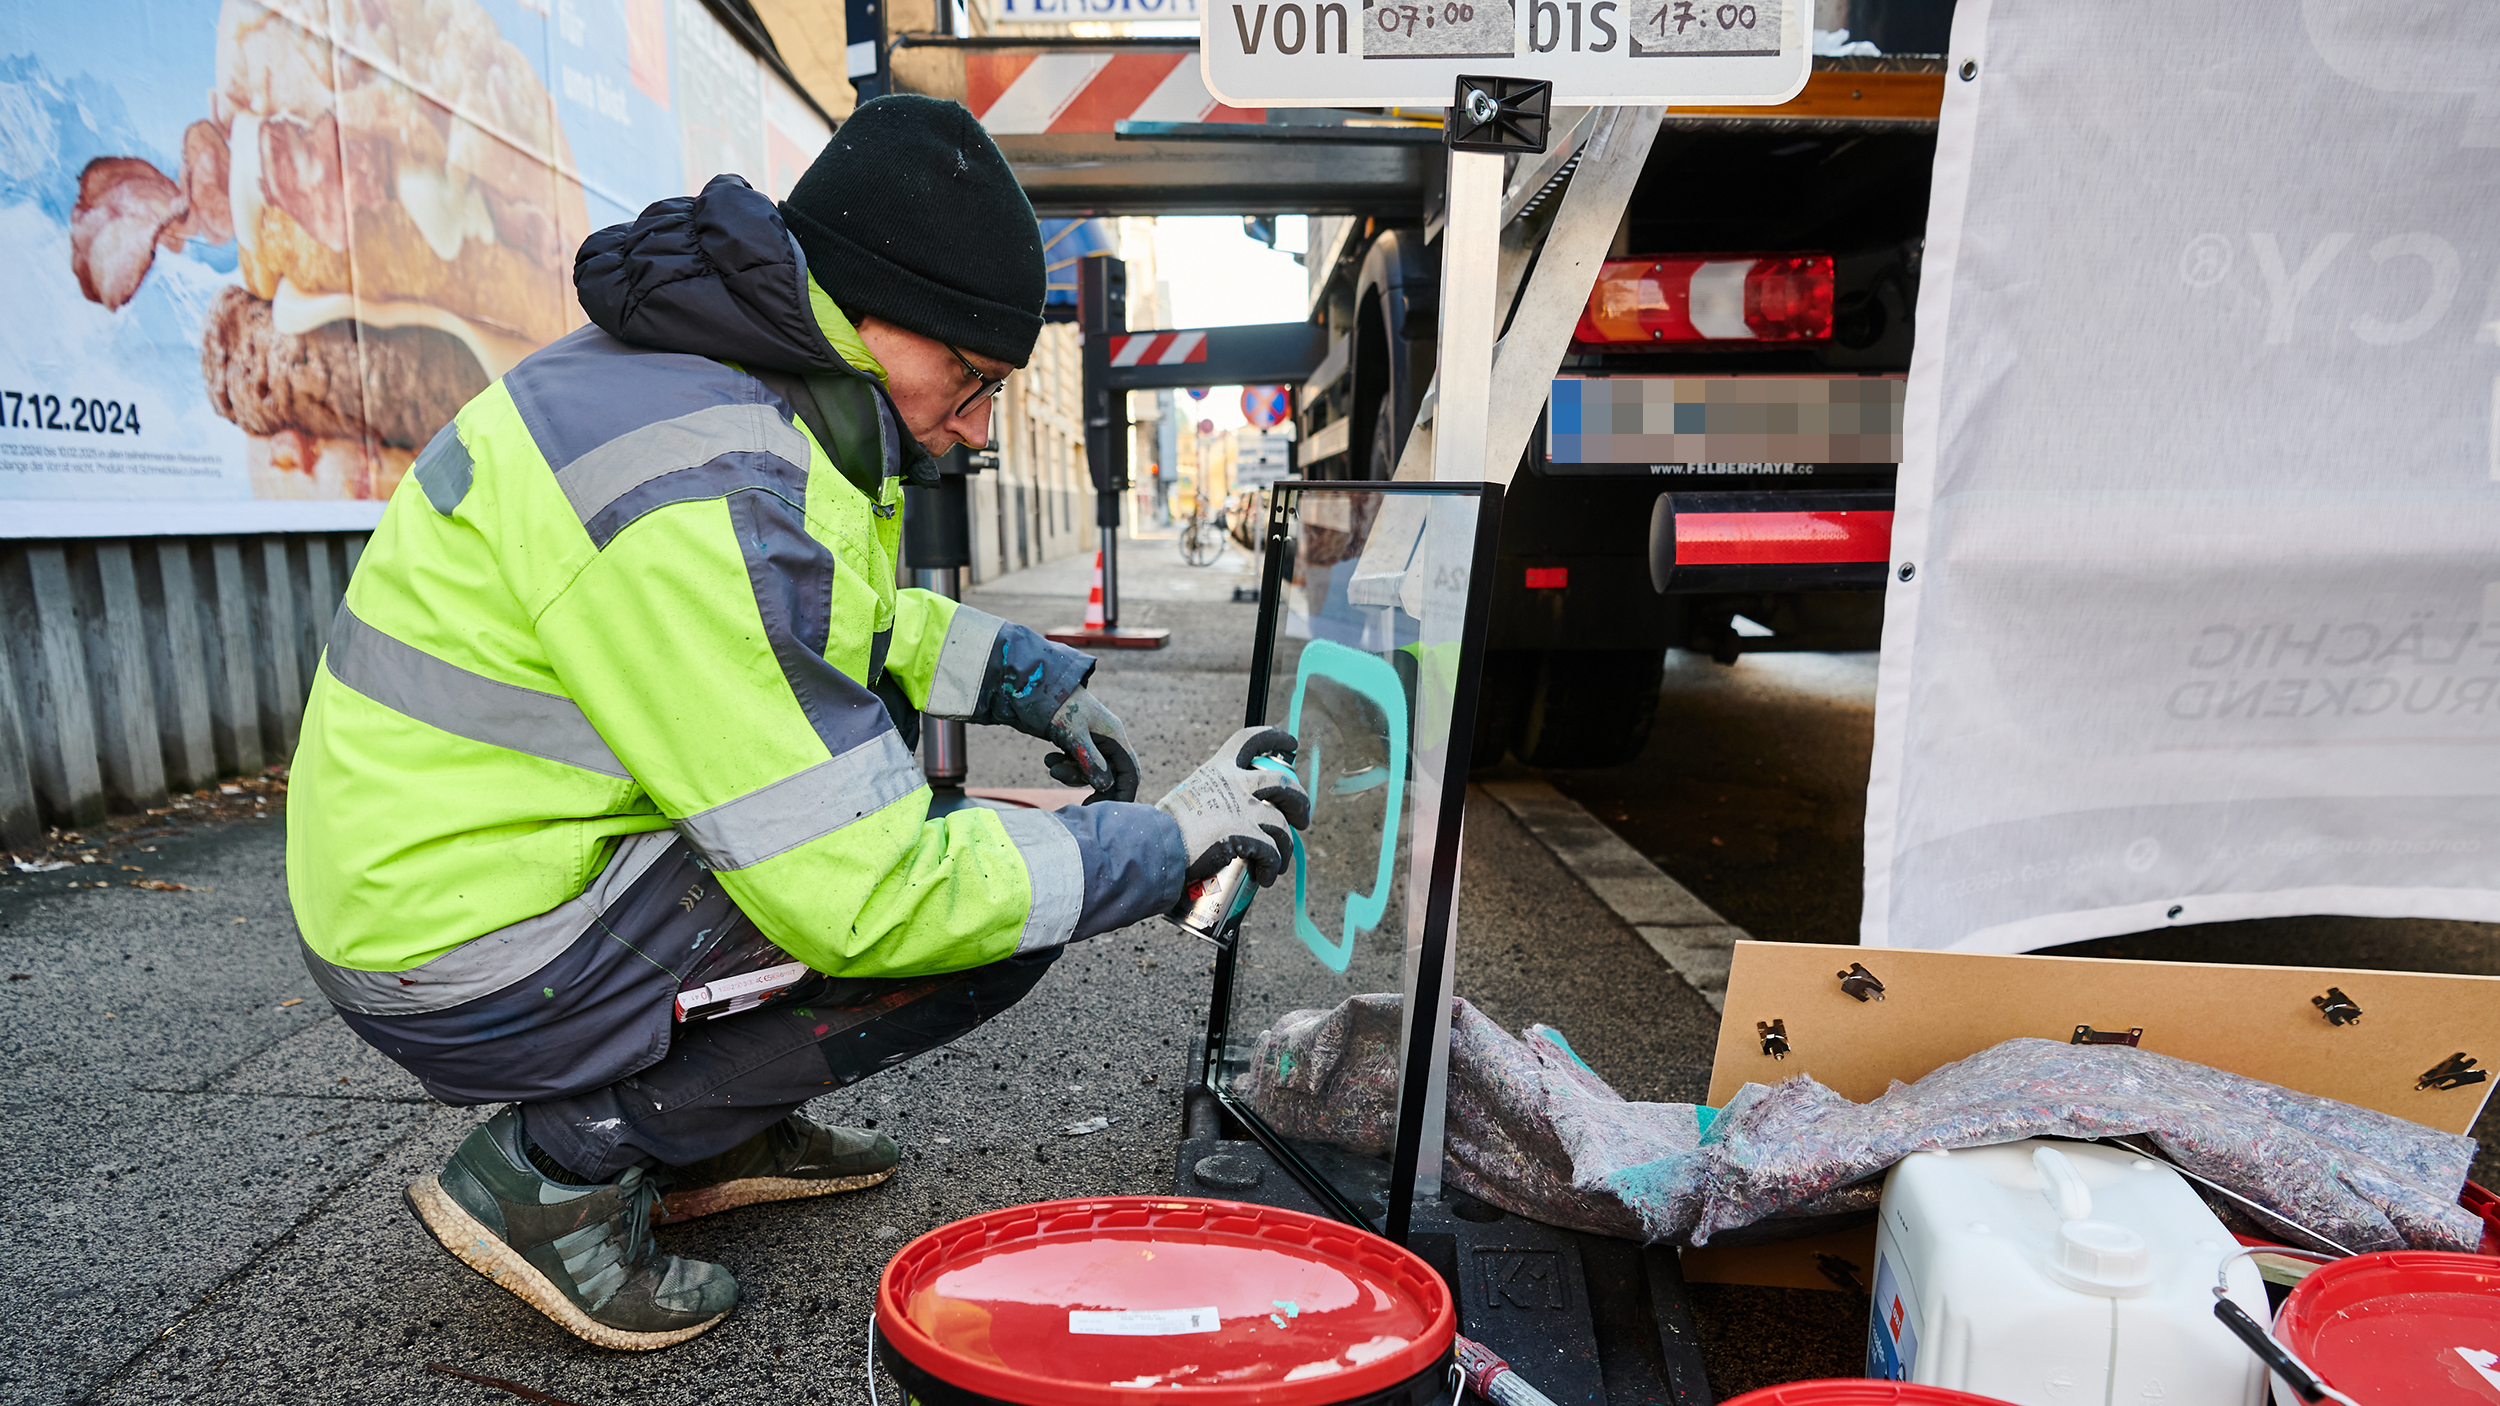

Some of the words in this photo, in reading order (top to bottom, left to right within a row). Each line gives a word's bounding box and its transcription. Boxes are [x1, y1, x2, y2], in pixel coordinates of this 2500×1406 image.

[1233, 3, 1348, 55] von
[1377, 2, 1477, 39] 07:00
[1530, 0, 1618, 53] bis
[1648, 3, 1758, 38] 17:00
[1650, 463, 1814, 475] www.FELBERMAYR.cc
